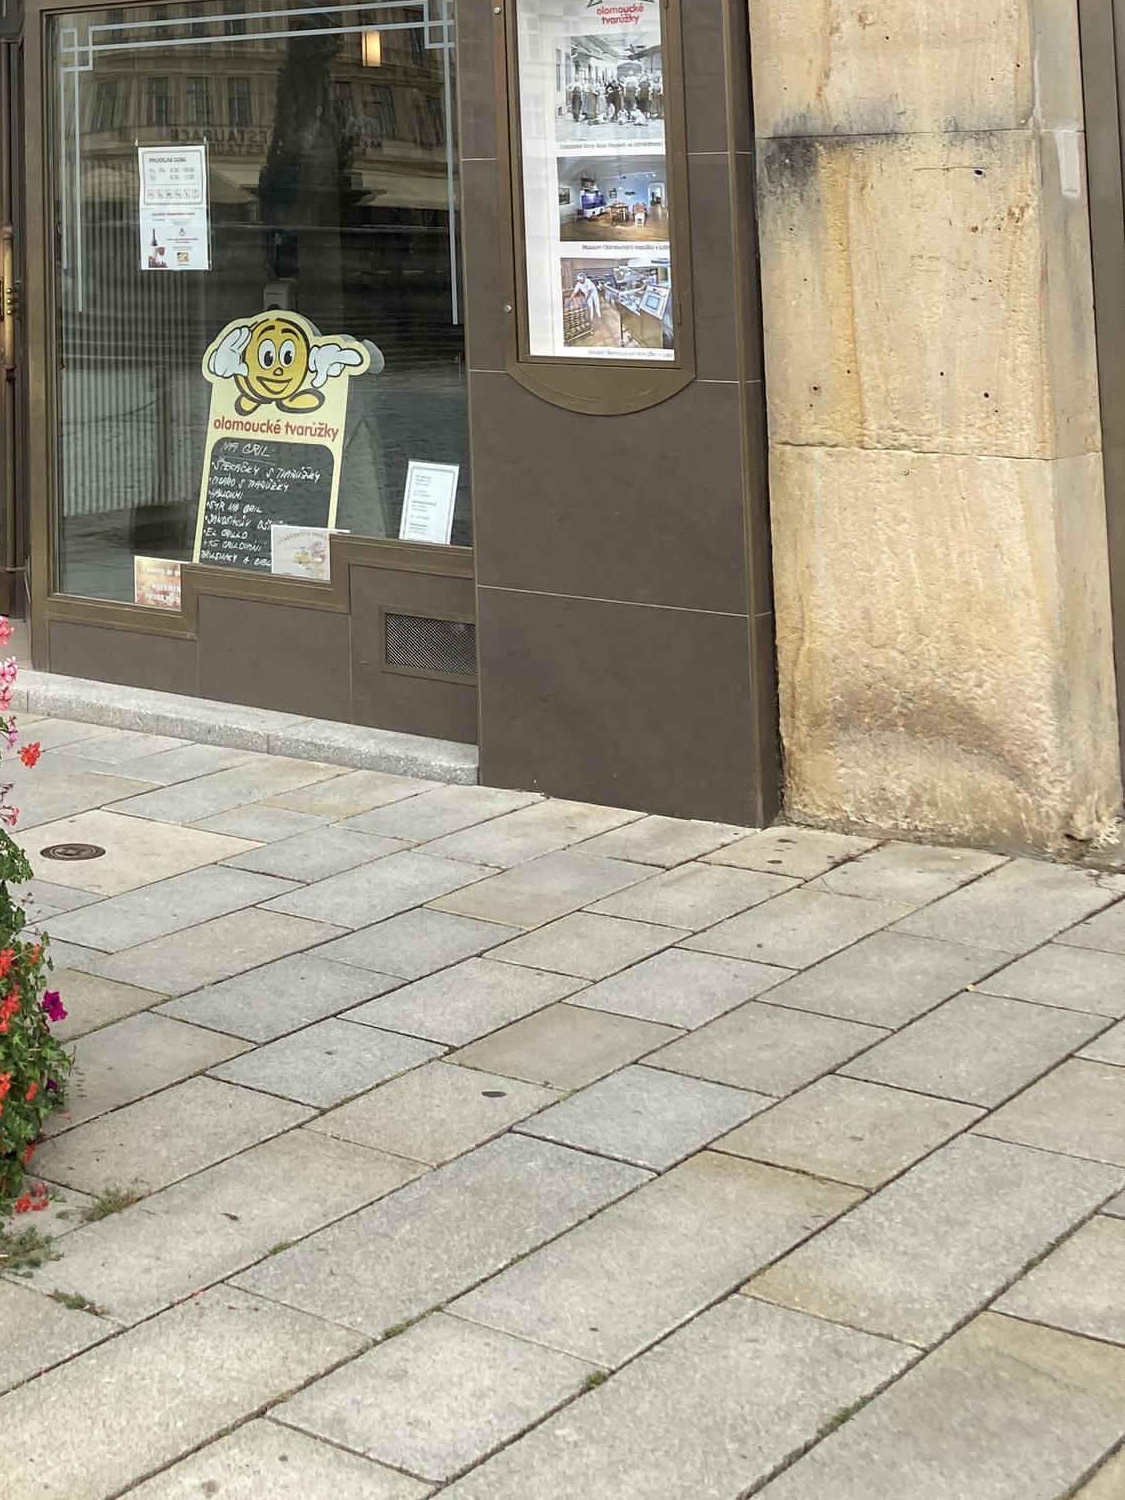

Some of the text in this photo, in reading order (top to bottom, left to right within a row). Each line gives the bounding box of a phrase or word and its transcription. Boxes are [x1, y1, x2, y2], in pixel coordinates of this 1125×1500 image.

[596, 2, 644, 15] olomoucké
[602, 13, 639, 25] tvarůžky
[213, 416, 339, 442] olomoucké tvarůžky
[220, 441, 271, 458] NA GRIL
